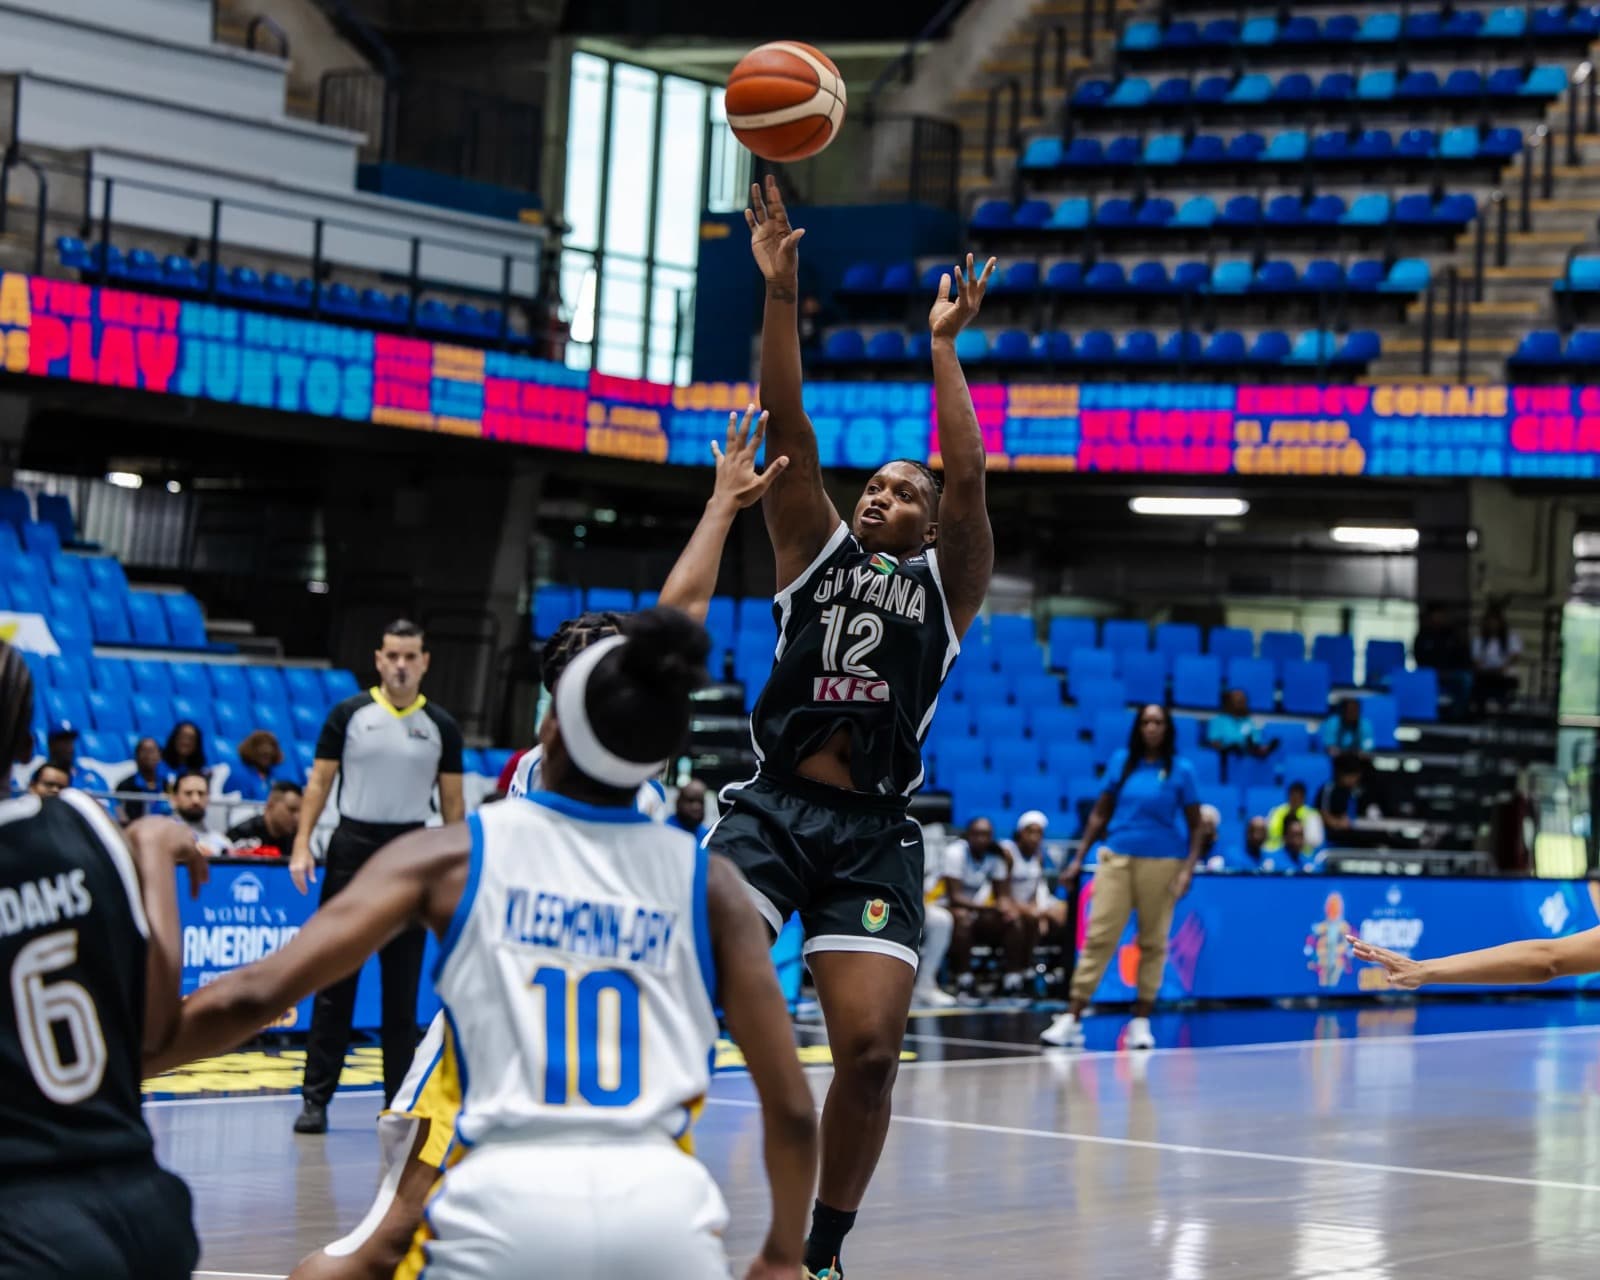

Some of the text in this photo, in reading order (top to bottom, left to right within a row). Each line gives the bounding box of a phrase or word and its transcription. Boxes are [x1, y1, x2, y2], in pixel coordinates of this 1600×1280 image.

[30, 276, 92, 318] THE
[29, 313, 180, 393] PLAY
[178, 337, 375, 421] JUNTOS
[1237, 385, 1369, 415] ENERGY
[1372, 385, 1509, 417] CORAJE
[813, 565, 926, 625] GUYANA
[819, 603, 884, 678] 12
[816, 677, 886, 702] KFC
[0, 867, 93, 939] DAMS
[10, 928, 108, 1105] 6
[527, 963, 643, 1108] 10
